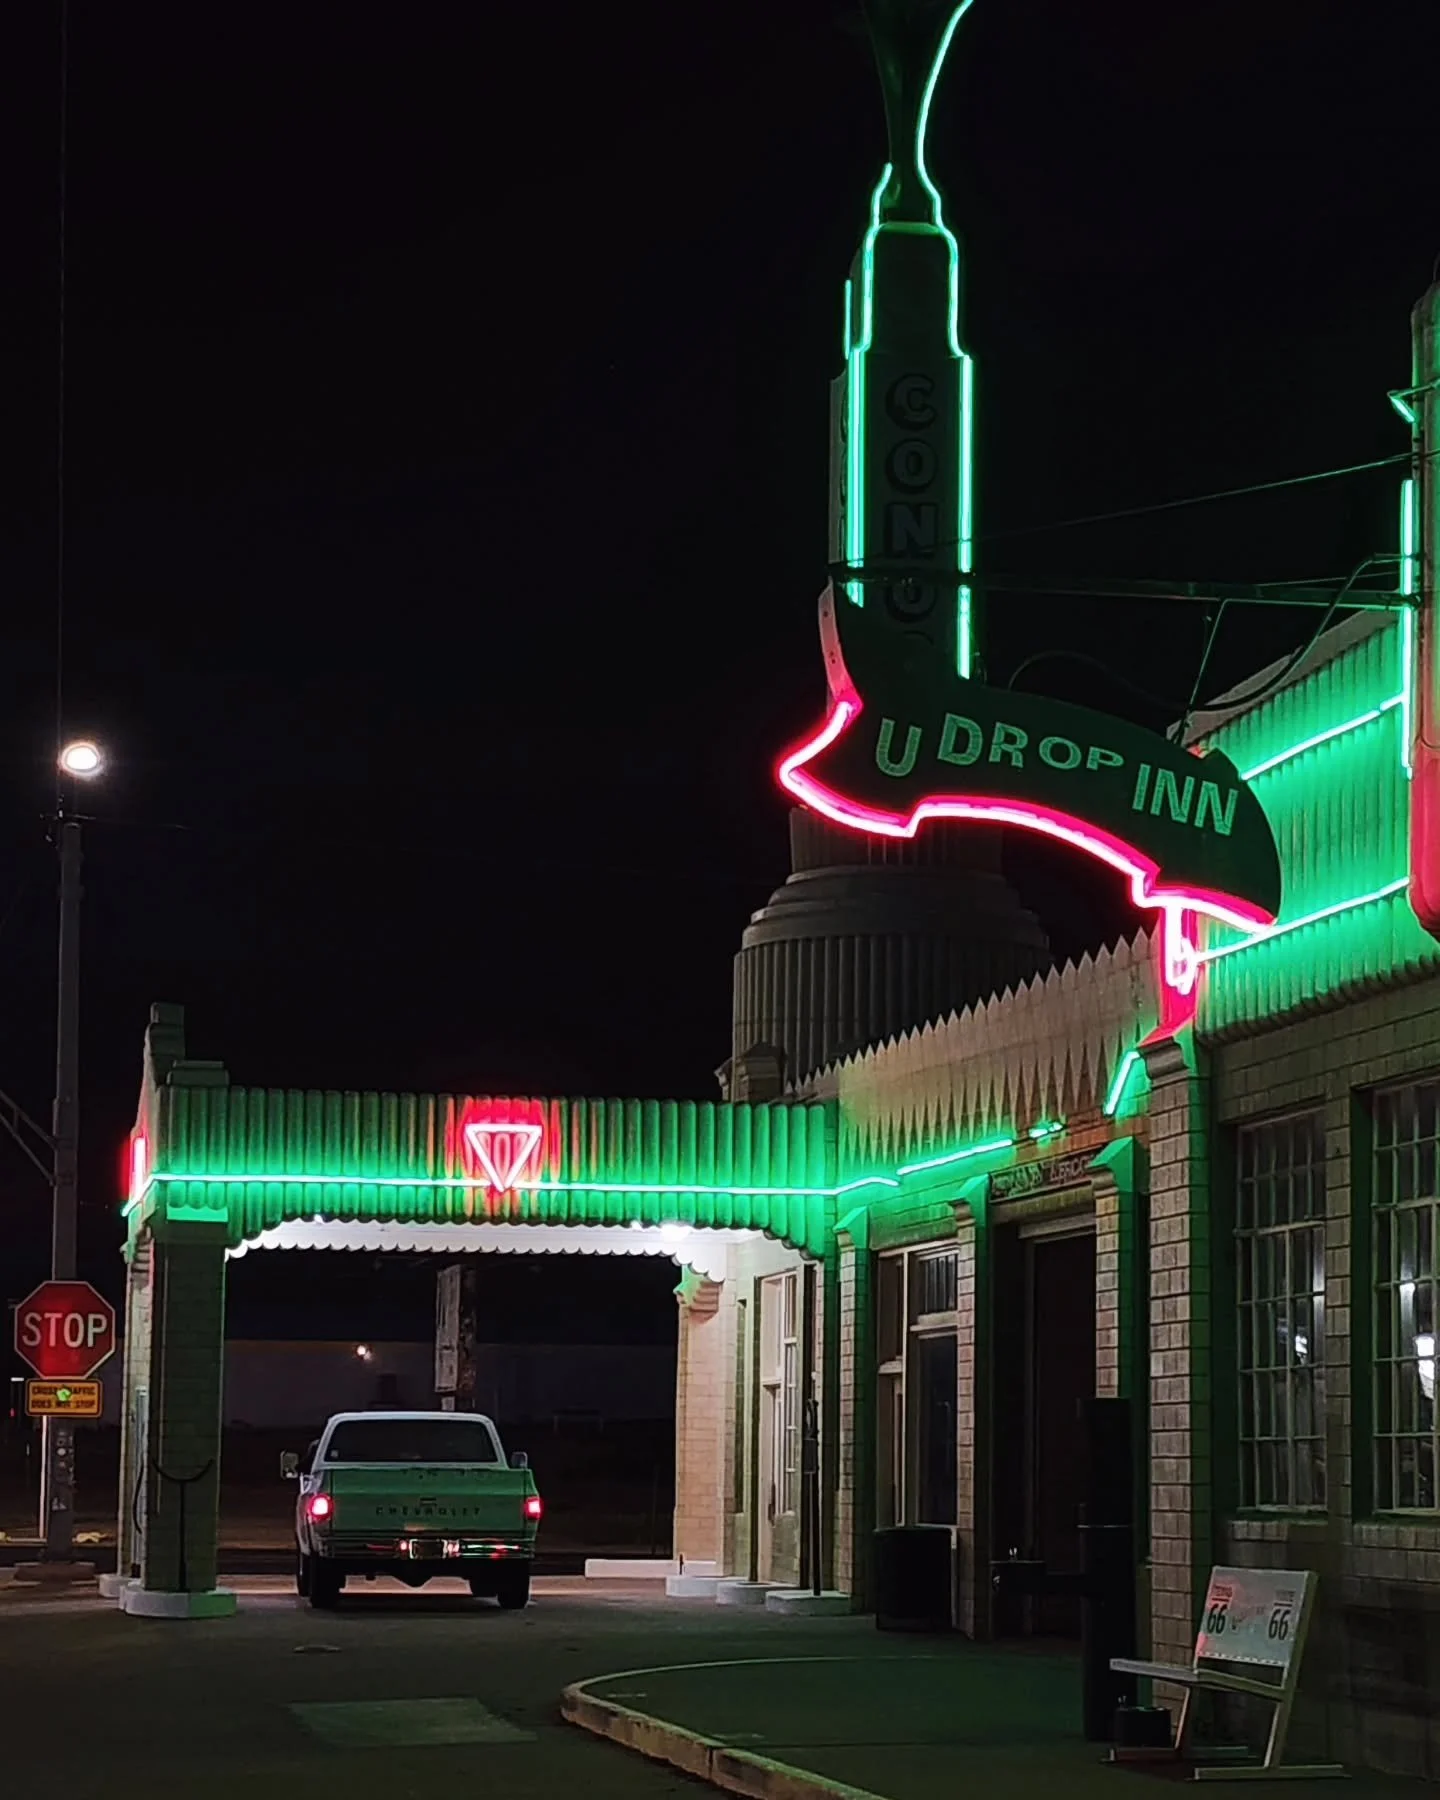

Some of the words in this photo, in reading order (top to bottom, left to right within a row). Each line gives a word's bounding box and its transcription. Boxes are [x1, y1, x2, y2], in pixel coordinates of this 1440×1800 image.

[884, 373, 939, 645] CONO
[936, 712, 1125, 773] DROP
[1131, 763, 1239, 837] INN
[22, 1312, 108, 1348] STOP
[376, 1506, 481, 1516] CHEVROLET
[1207, 1603, 1228, 1634] 66
[1269, 1608, 1291, 1640] 66
